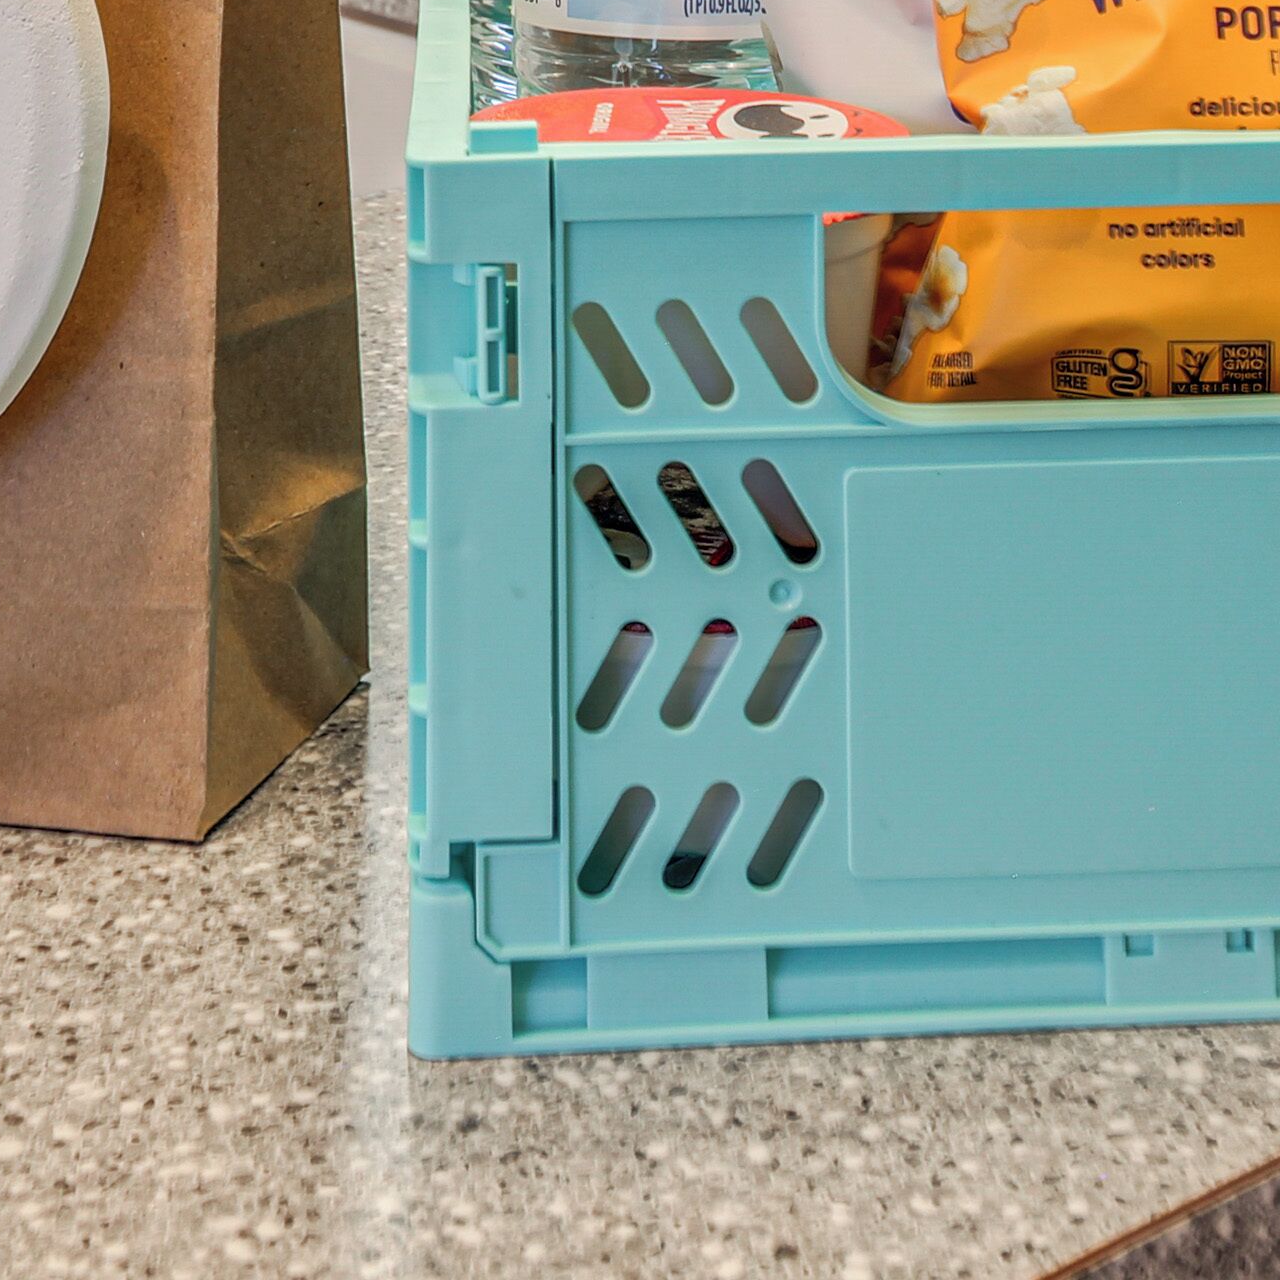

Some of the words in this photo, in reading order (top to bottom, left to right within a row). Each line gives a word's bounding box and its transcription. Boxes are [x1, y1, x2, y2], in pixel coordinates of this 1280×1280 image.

[1108, 222, 1138, 239] no
[1143, 217, 1246, 238] artificial
[1141, 250, 1216, 270] colors
[1223, 346, 1266, 359] NON
[1055, 360, 1108, 377] GLUTEN
[1223, 358, 1266, 371] GMO
[1056, 374, 1088, 390] FREE
[1223, 370, 1264, 381] Project
[1177, 382, 1264, 394] VERIFIED
